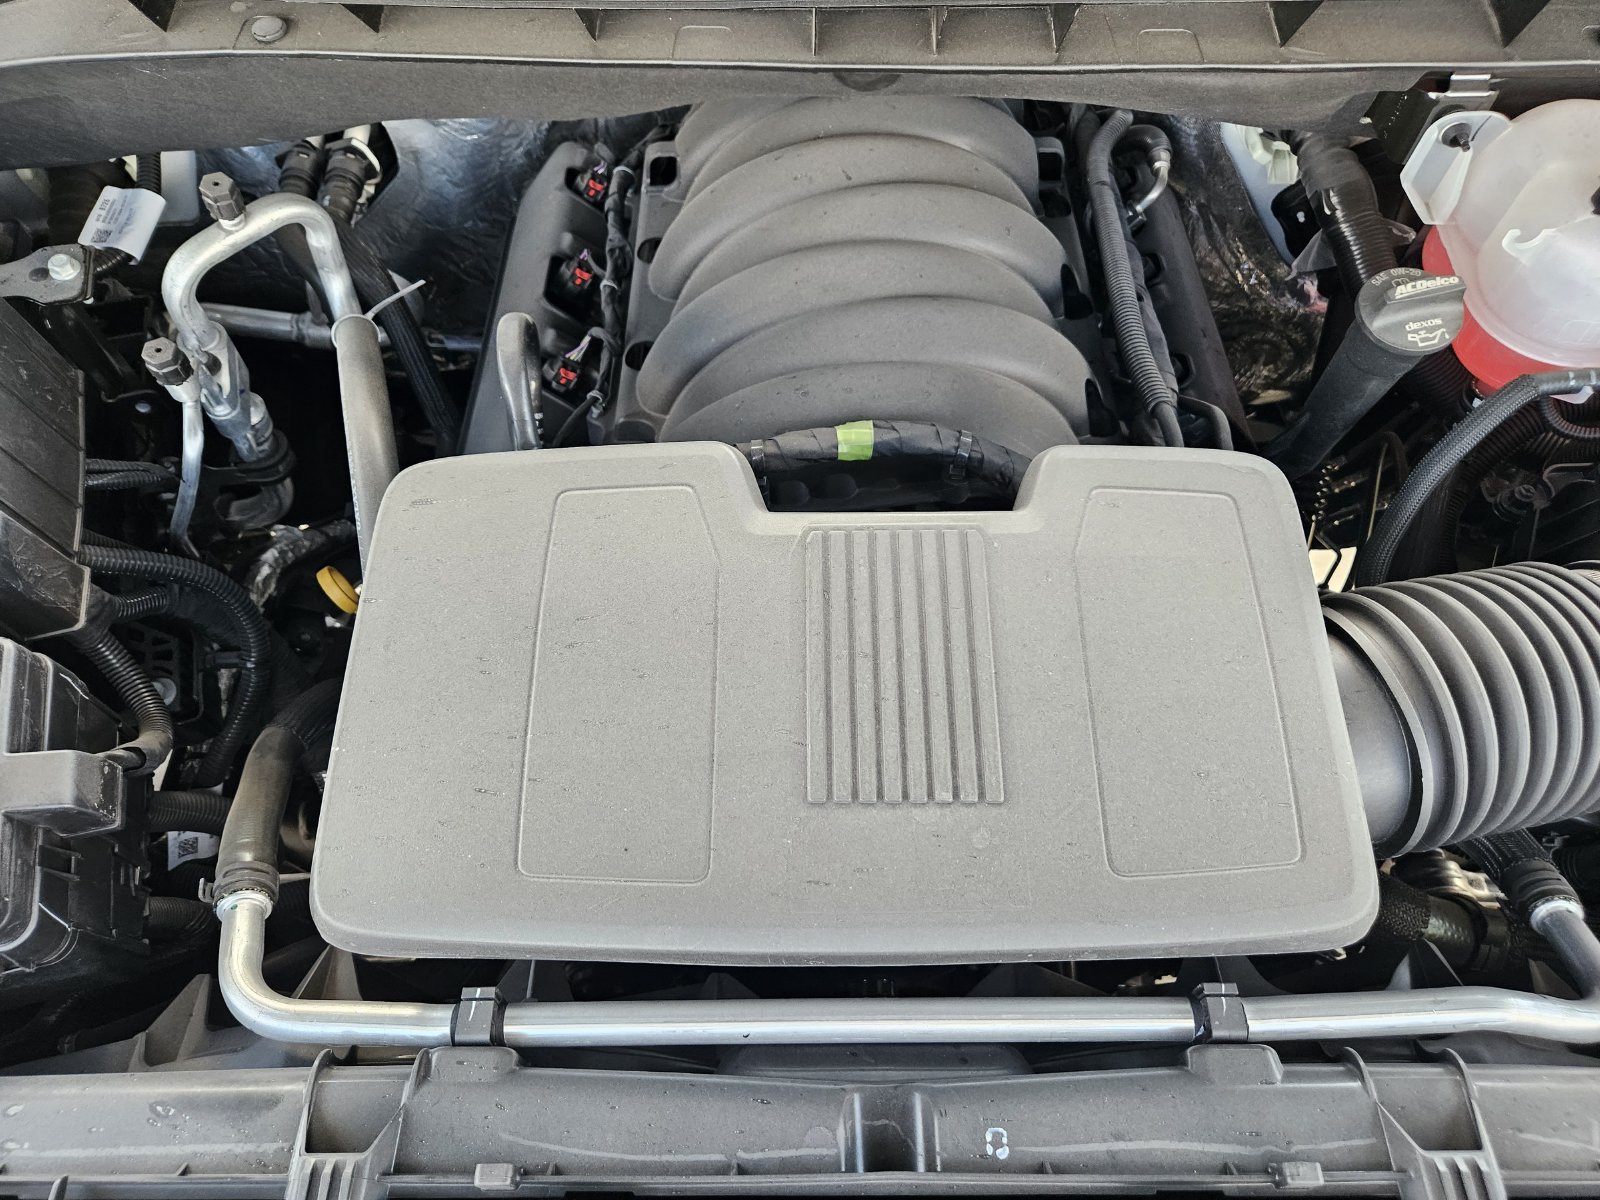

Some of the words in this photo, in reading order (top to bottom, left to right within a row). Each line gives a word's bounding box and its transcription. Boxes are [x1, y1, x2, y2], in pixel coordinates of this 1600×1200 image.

[1371, 272, 1389, 286] SAE
[1390, 268, 1421, 277] 0W-20
[1394, 276, 1460, 297] ACDelco
[1405, 318, 1443, 331] dexos
